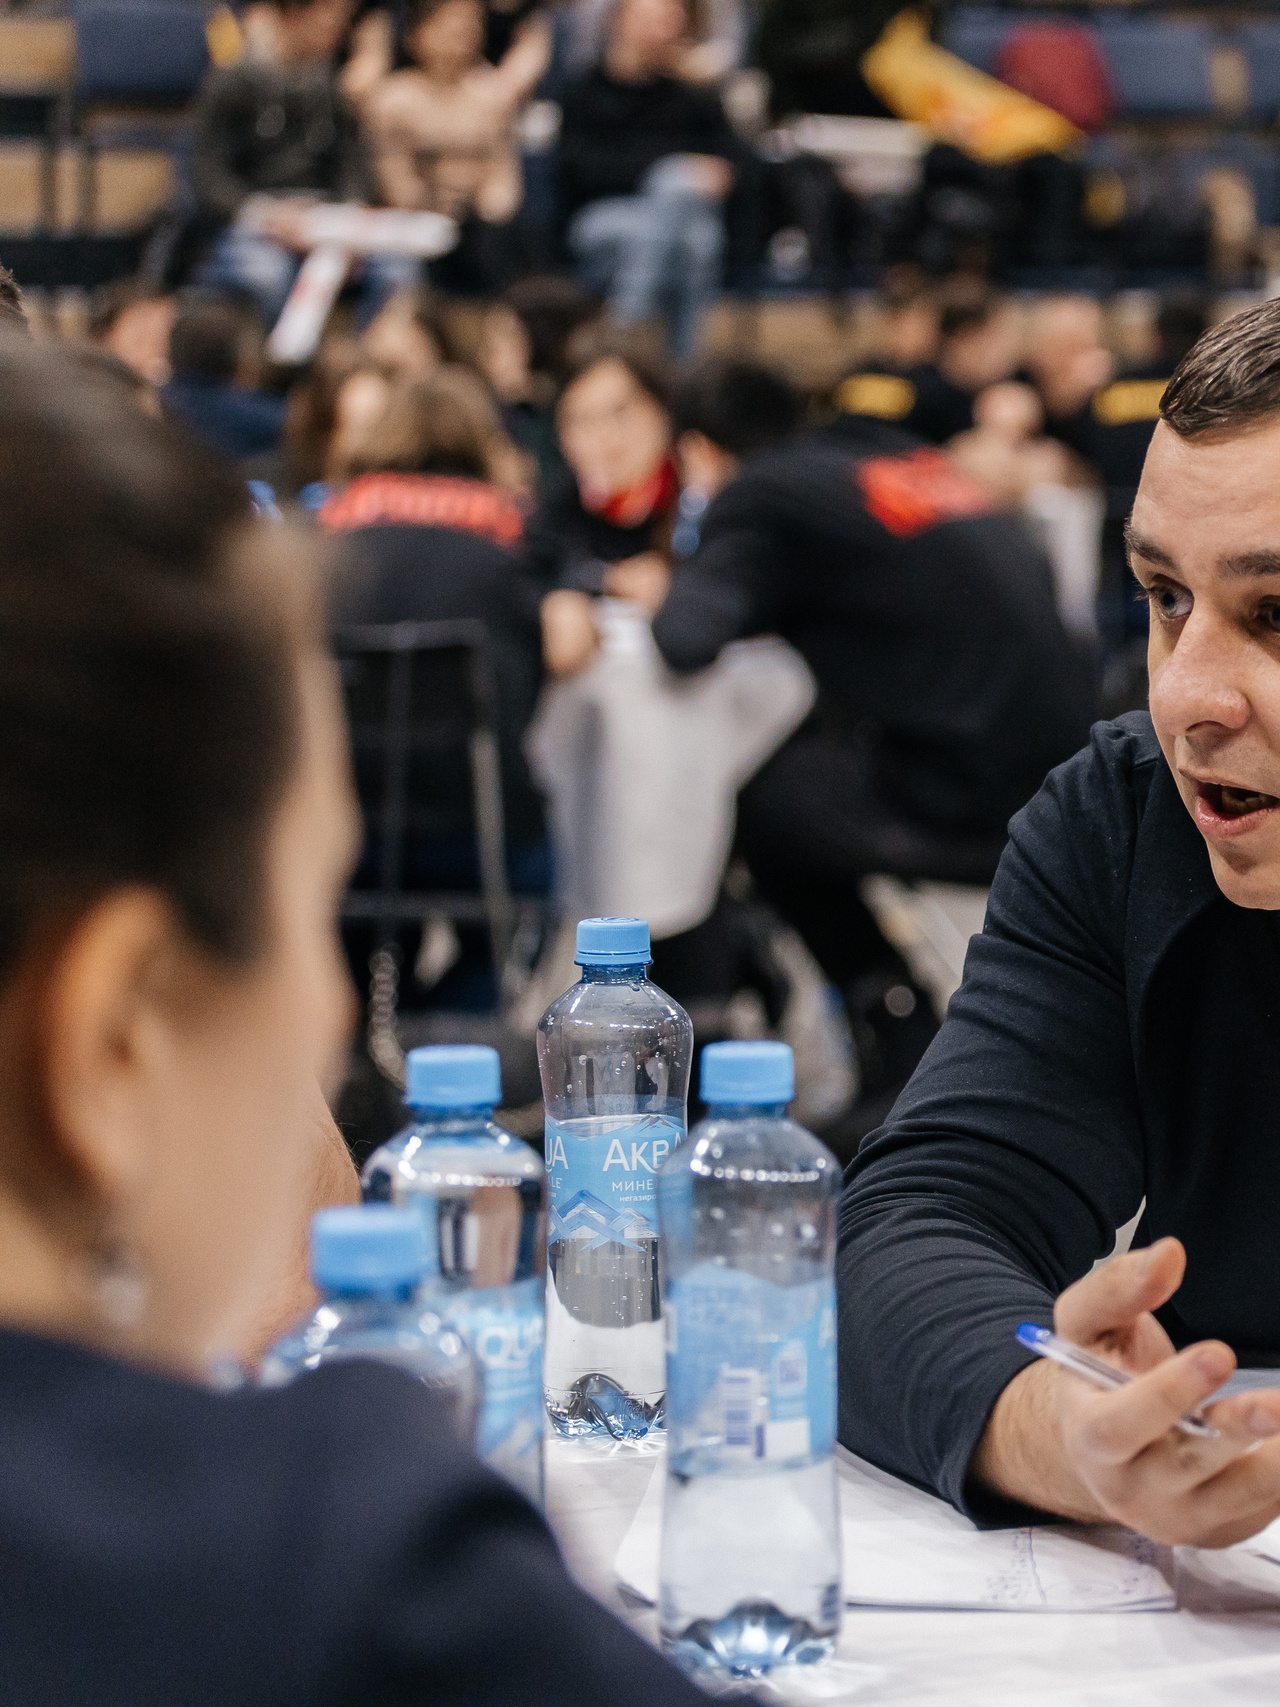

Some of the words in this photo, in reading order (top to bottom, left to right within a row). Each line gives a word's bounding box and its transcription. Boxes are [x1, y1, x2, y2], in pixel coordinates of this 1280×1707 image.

[545, 1135, 569, 1173] UA
[611, 1178, 654, 1192] МИНЕ
[619, 1193, 657, 1202] негазиро
